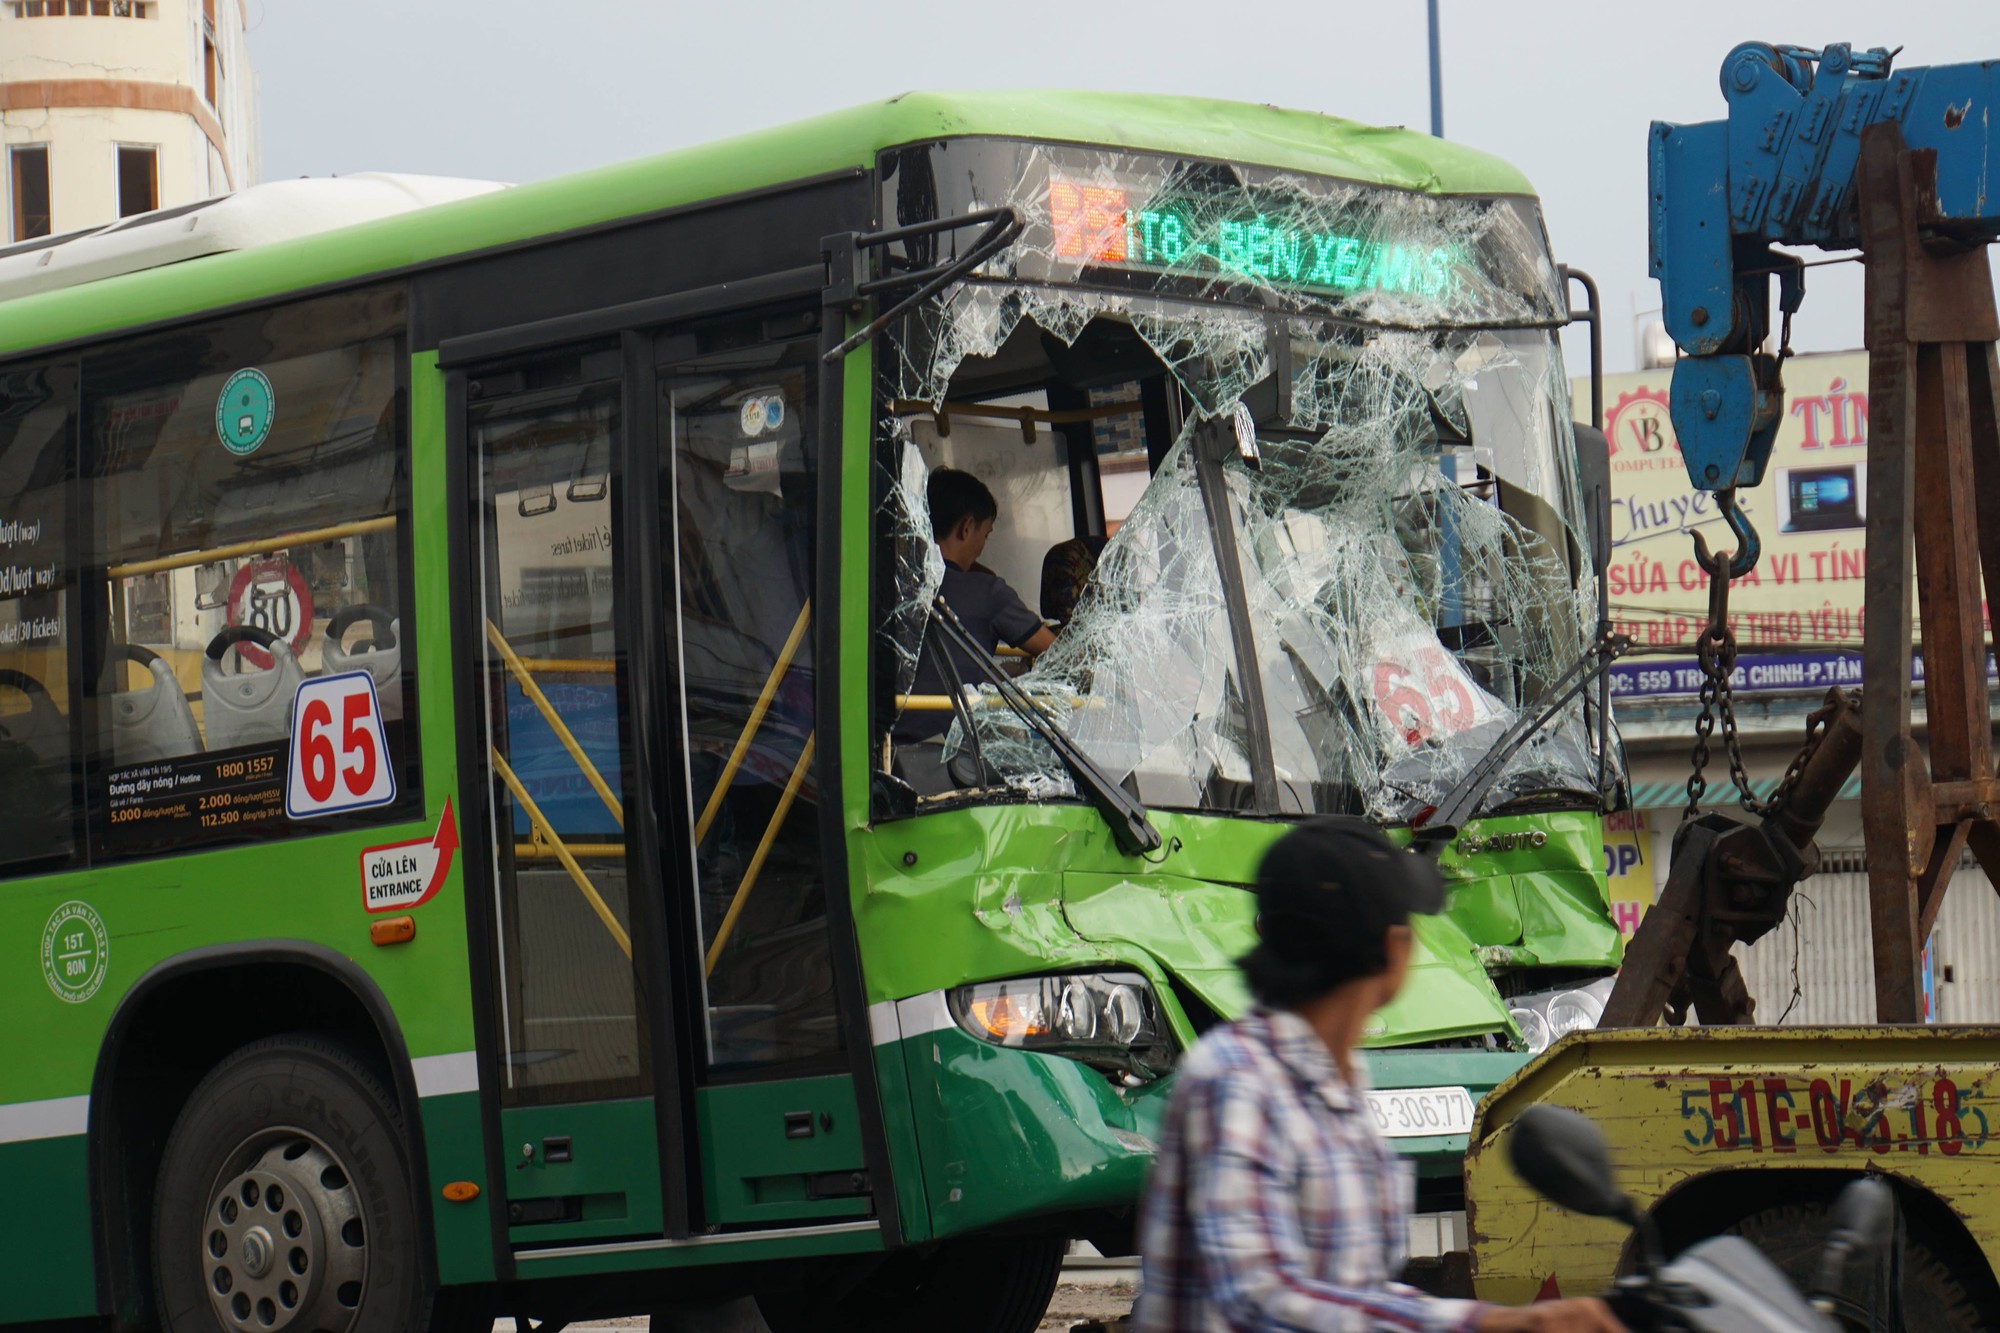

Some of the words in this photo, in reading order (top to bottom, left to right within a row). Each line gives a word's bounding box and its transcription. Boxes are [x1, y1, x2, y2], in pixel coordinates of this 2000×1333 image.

[1310, 233, 1361, 286] XE
[1611, 455, 1685, 474] OMPUTE
[1609, 550, 1669, 595] SỬA
[1771, 552, 1800, 585] VI
[249, 588, 292, 638] 80
[1746, 610, 1801, 646] THEO
[1808, 600, 1849, 640] YÊU
[1637, 670, 1672, 691] 559
[300, 692, 377, 803] 65
[215, 761, 244, 779] 1800
[246, 756, 274, 774] 1557
[109, 782, 135, 796] Đường
[136, 779, 151, 793] dây
[153, 776, 174, 789] nóng
[179, 774, 201, 785] Hotline
[199, 792, 231, 810] 2.000
[111, 807, 141, 823] 5.000
[200, 810, 239, 828] 112.500
[267, 807, 275, 817] 30
[1486, 829, 1548, 853] AUTO
[371, 856, 393, 879] CỬA
[396, 854, 417, 875] LÊN
[369, 878, 422, 900] ENTRANCE
[64, 932, 84, 951] 15T
[66, 958, 86, 977] 80N
